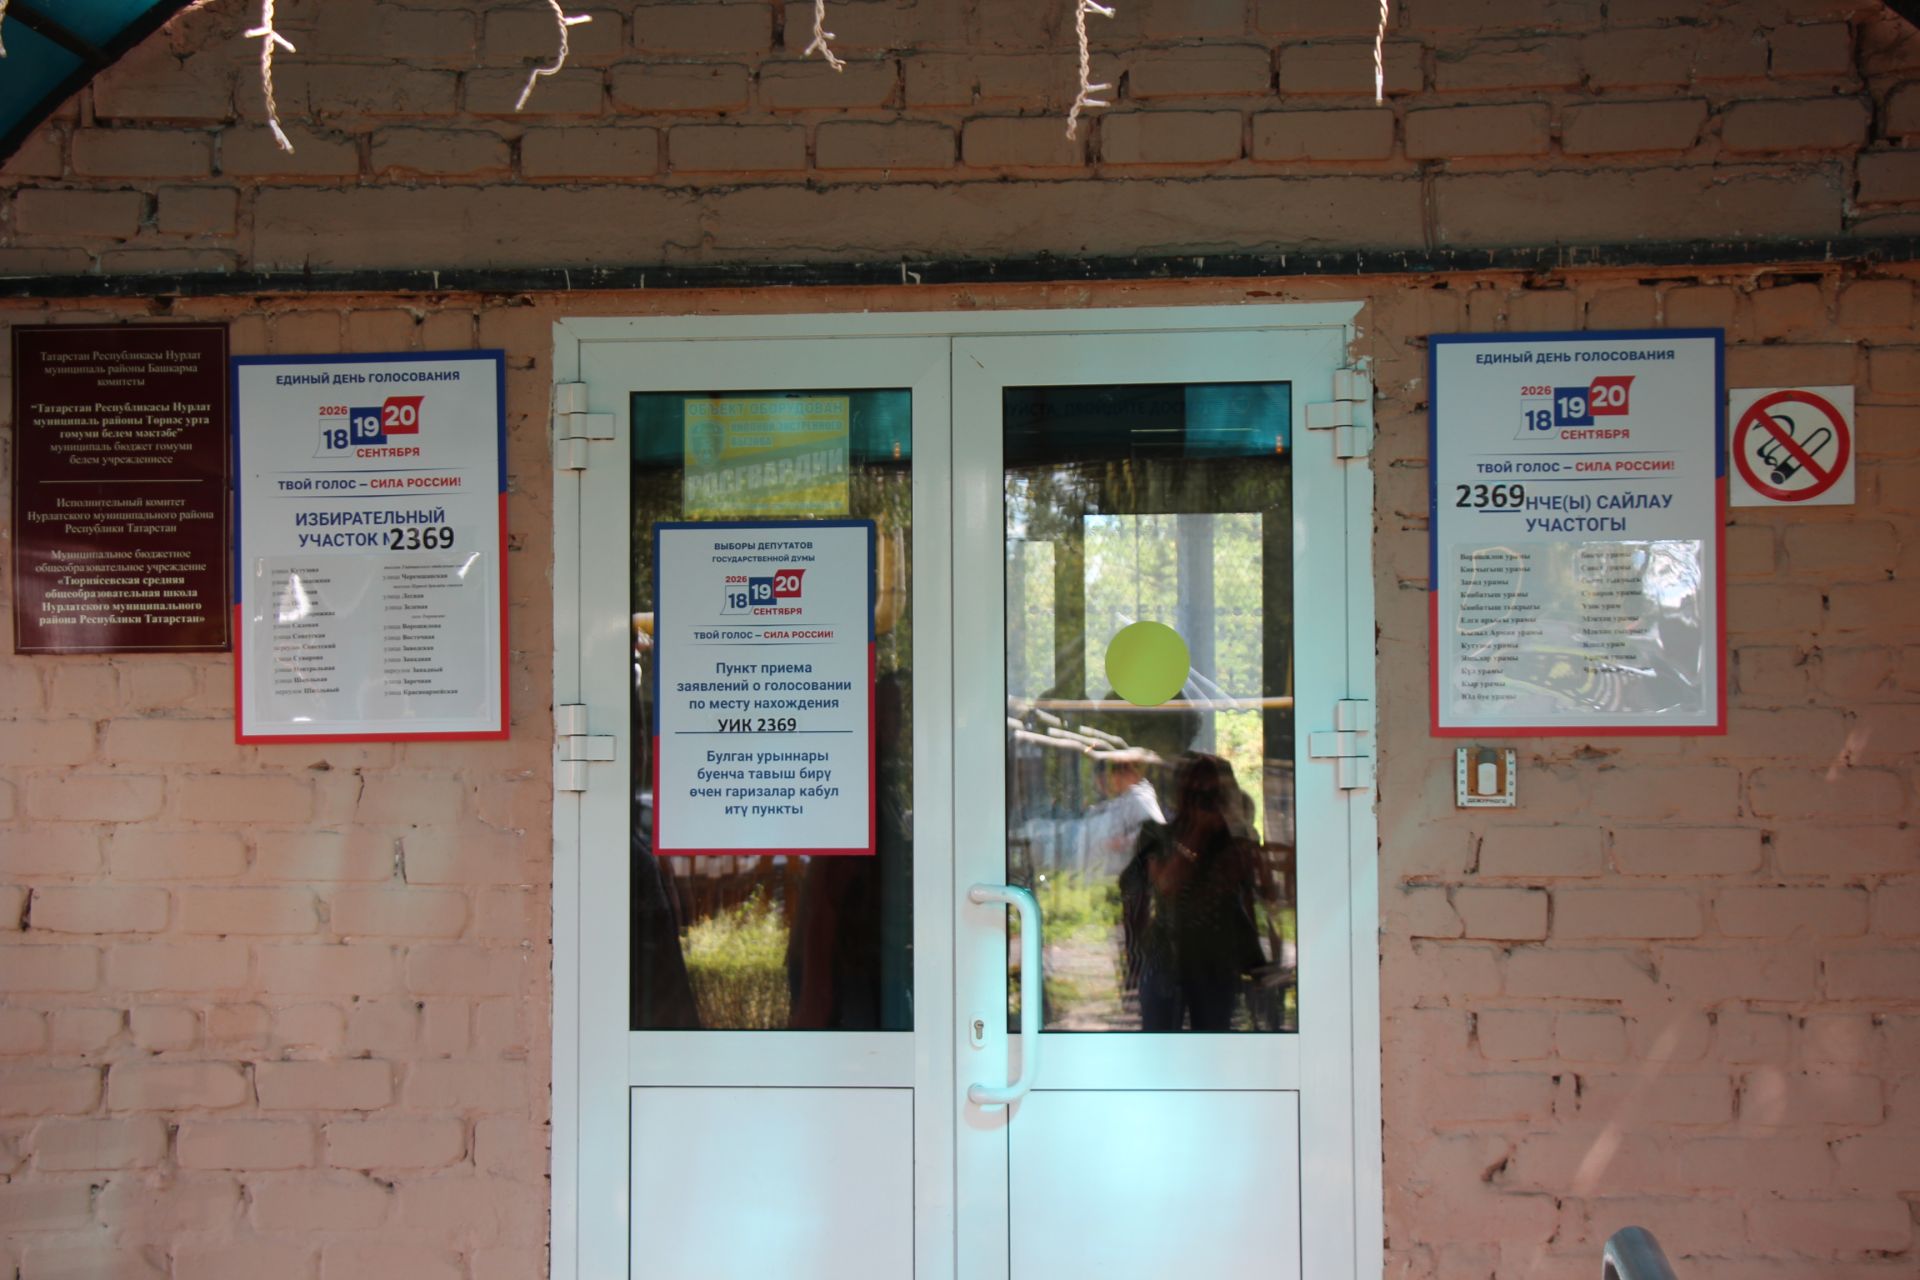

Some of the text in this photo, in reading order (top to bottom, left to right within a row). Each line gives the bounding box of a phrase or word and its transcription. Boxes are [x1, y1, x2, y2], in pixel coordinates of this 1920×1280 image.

[40, 350, 201, 362] Татарстан Республикасы Нурлат
[1475, 350, 1675, 365] ЕДИНЫЙ ДЕНЬ ГОЛОСОВАНИЯ
[44, 363, 198, 375] муниципаль районы Башкарма
[97, 377, 145, 387] комитеты
[276, 371, 460, 385] ЕДИНЫЙ ДЕНЬ ГОЛОСОВАНИЯ
[1520, 385, 1552, 396] 2026
[94, 402, 170, 414] Республикасы
[172, 402, 211, 414] Нурлат
[319, 406, 348, 415] 2026
[688, 401, 843, 416] ОБЪЕКТ ОБОРУДОВАН
[1524, 385, 1626, 431] 18 19 20
[32, 416, 100, 427] муниципаль
[101, 415, 143, 426] районы
[185, 416, 210, 426] урта
[59, 429, 99, 439] гомуми
[101, 428, 133, 438] белем
[323, 405, 416, 450] 18 19 20
[1560, 429, 1630, 440] СЕНТЯБРЯ
[50, 441, 192, 453] муниципаль бюджет гомуми
[356, 447, 420, 458] СЕНТЯБРЯ
[69, 454, 99, 465] белем
[1477, 461, 1513, 474] ТВОЙ
[1516, 462, 1560, 473] ГОЛОС
[1575, 461, 1611, 472] СИЛА
[1615, 460, 1675, 471] РОССИИ!
[686, 448, 843, 500] РОСГВАРДИИ
[278, 478, 312, 490] ТВОЙ
[315, 479, 356, 489] ГОЛОС
[370, 478, 404, 489] СИЛА
[407, 477, 461, 488] РОССИИ!
[56, 497, 185, 508] Исполнительный комитет
[1455, 483, 1525, 508] 2369
[1596, 490, 1673, 510] САЙЛАУ
[27, 509, 214, 522] Нурлатского муниципального района
[295, 506, 445, 526] ИЗБИРАТЕЛЬНЫЙ
[65, 523, 177, 535] Республики Татарстан
[1526, 516, 1625, 533] УЧАСТОГЫ
[298, 532, 377, 548] УЧАСТОК
[714, 541, 813, 551] ВЫБОРЫ ДЕПУТАТОВ
[50, 548, 191, 560] Муниципальное бюджетное
[711, 554, 815, 564] ГОСУДАРСТВЕННОЙ ДУМЫ
[35, 562, 207, 573] общеобразовательное учреждение
[142, 575, 185, 585] средняя
[725, 575, 747, 583] 2026
[44, 587, 197, 599] общеобразовательная школа
[728, 576, 800, 609] 18 19 20
[42, 600, 202, 612] Нурлатского муниципального
[753, 607, 802, 616] СЕНТЯБРЯ
[39, 614, 77, 625] района
[79, 614, 142, 625] Республики
[693, 630, 719, 640] ТВОЙ
[720, 630, 753, 640] ГОЛОС
[763, 630, 789, 639] СИЛА
[791, 630, 834, 639] РОССИИ!
[715, 662, 812, 676] Пункт приема
[677, 679, 851, 693] заявлений о голосовании
[688, 698, 839, 711] по месту нахождения
[718, 718, 797, 733] УИК 2369
[706, 750, 829, 765] Булган урыннары
[697, 767, 832, 783] буенча тавыш бирү
[689, 785, 839, 801] өчен гаризалар кабул
[724, 804, 803, 818] итү пункты
